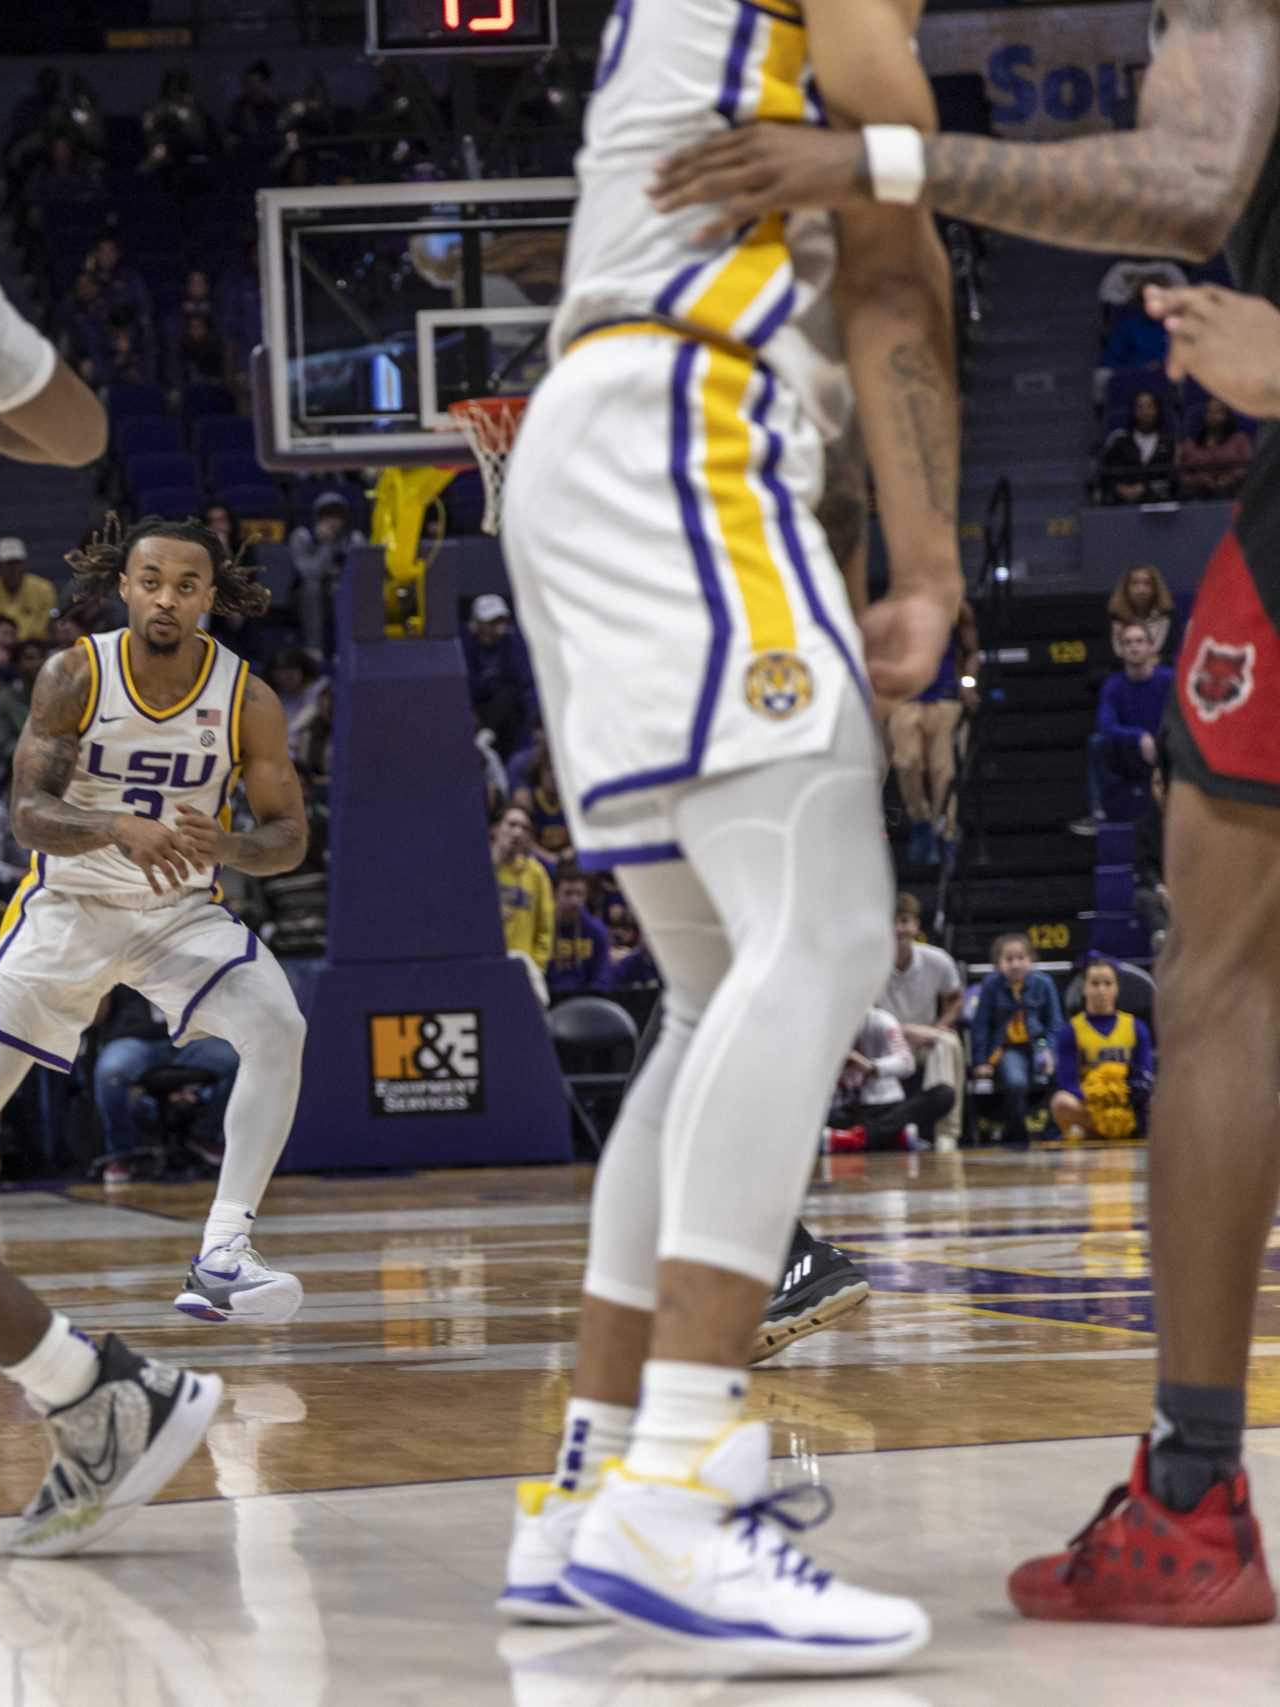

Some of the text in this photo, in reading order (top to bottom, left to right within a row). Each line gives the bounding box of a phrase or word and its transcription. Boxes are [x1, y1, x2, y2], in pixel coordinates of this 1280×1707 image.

[87, 742, 218, 788] LSU
[1028, 924, 1069, 949] 120
[372, 1013, 479, 1079] H&E
